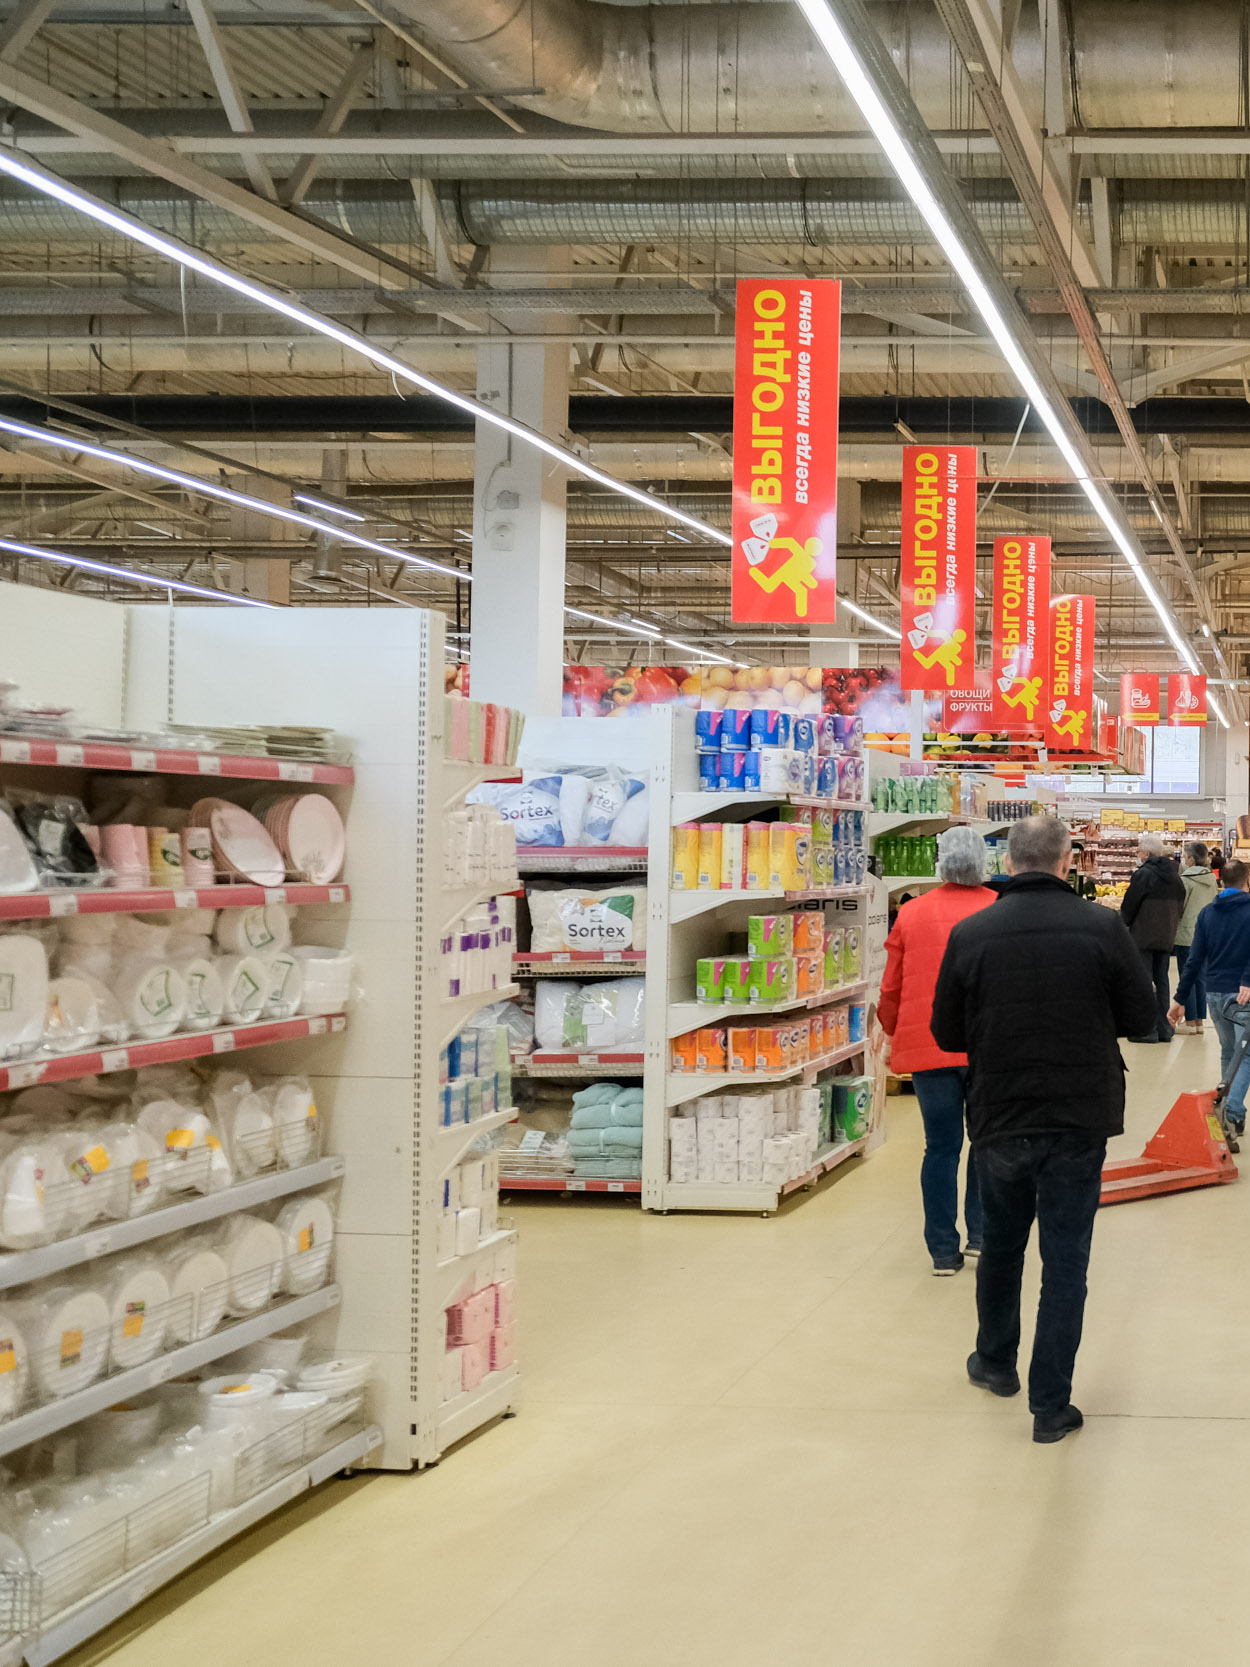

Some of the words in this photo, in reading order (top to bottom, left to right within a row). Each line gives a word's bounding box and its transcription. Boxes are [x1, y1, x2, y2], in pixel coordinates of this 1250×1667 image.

[798, 289, 814, 346] цены
[750, 289, 792, 504] ВЫГОДНО
[797, 351, 812, 427] низкие
[795, 433, 812, 504] всегда
[914, 452, 943, 606] ВЫГОДНО
[946, 497, 957, 551] низкие
[1027, 542, 1037, 573] цены
[945, 554, 958, 606] всегда
[1002, 541, 1025, 659] ВЫГОДНО
[1026, 575, 1036, 617] низкие
[1076, 599, 1085, 625] цены
[1025, 619, 1036, 660] всегда
[1053, 599, 1074, 696] ВЫГОДНО
[1075, 626, 1083, 662] низкие
[950, 689, 991, 700] ОВОЩИ
[1073, 662, 1084, 697] всегда
[950, 702, 993, 712] ФРУКТЫ
[500, 805, 554, 821] Sortex
[568, 923, 626, 938] Sortex
